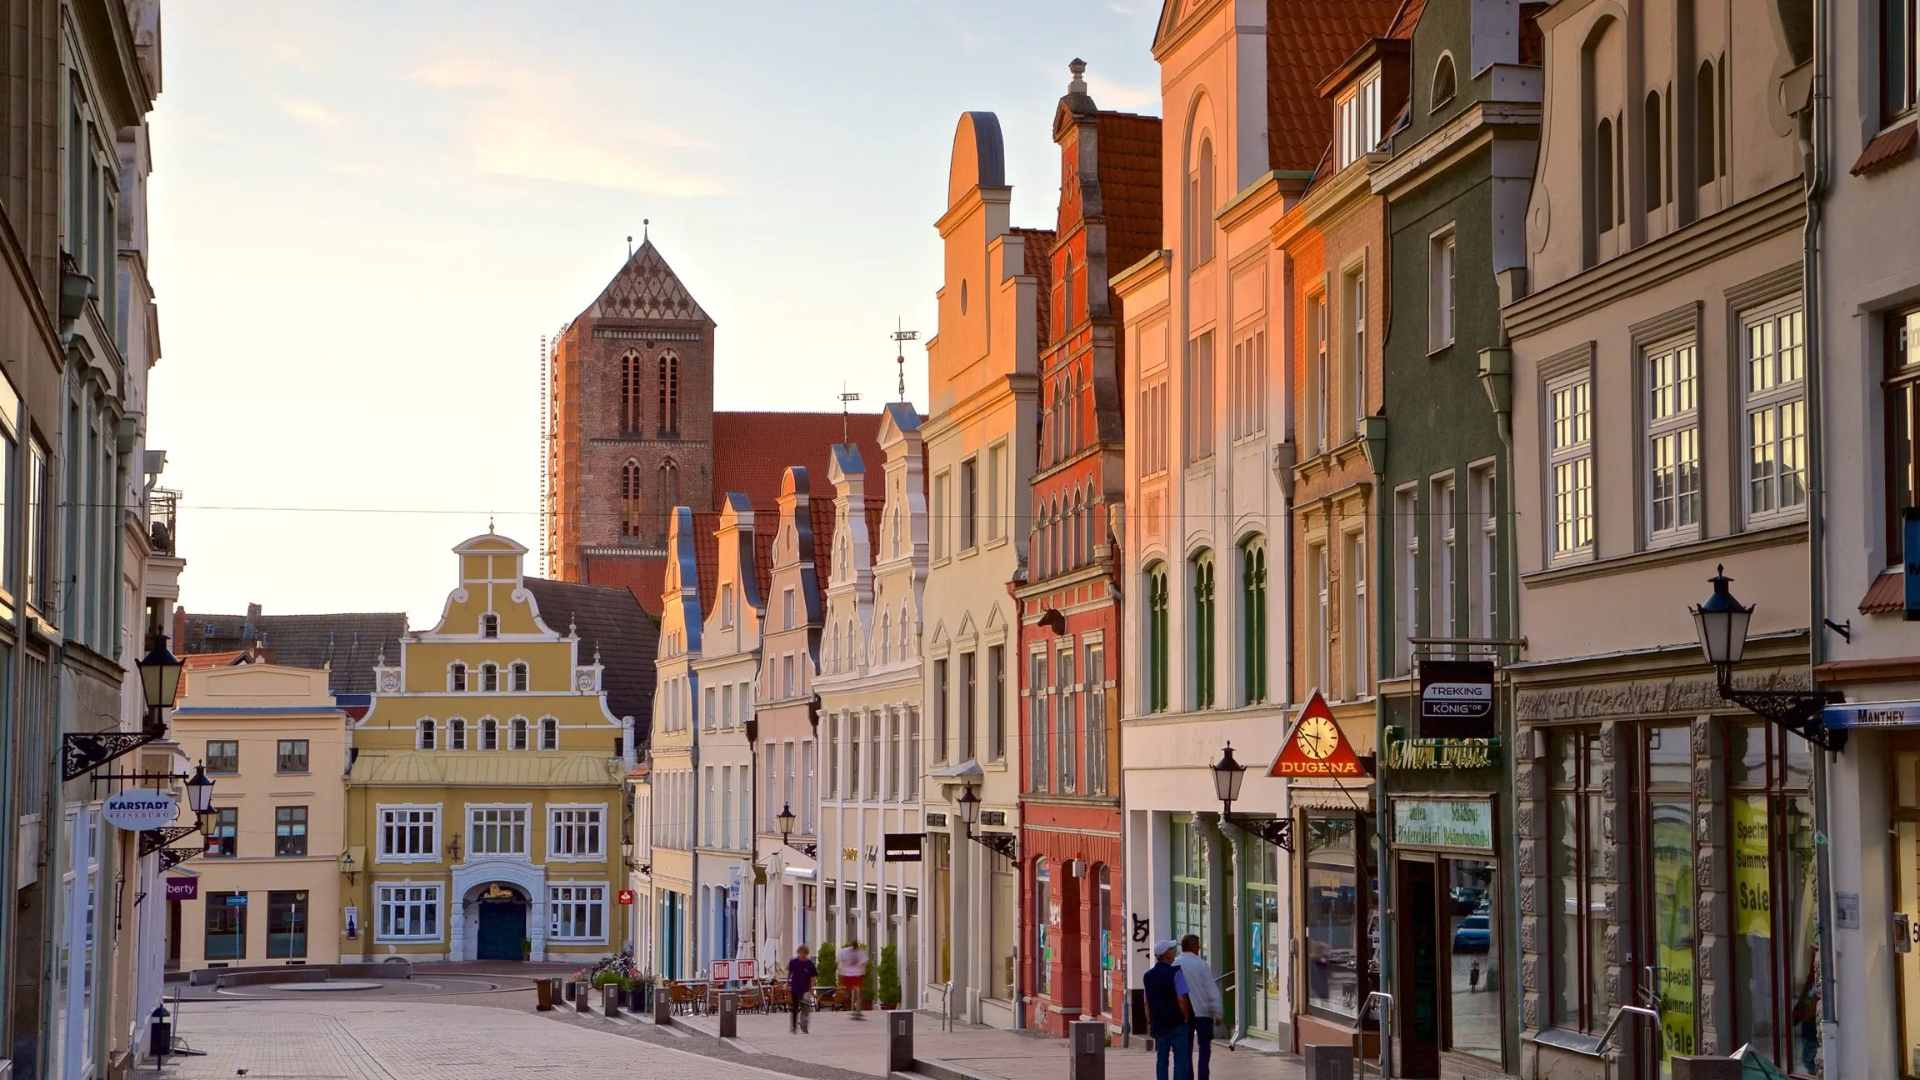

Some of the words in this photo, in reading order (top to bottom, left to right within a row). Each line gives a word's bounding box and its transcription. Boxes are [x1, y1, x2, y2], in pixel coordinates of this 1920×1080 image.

[1431, 687, 1482, 696] TREKKING
[1433, 703, 1469, 713] KÖNIG
[1281, 762, 1358, 773] DUGENA
[109, 801, 169, 810] KARSTADT
[1737, 821, 1768, 843] Special
[166, 883, 194, 895] berty
[1740, 881, 1769, 912] Sale
[1662, 992, 1692, 1015] Summer
[1665, 1023, 1692, 1055] Sale
